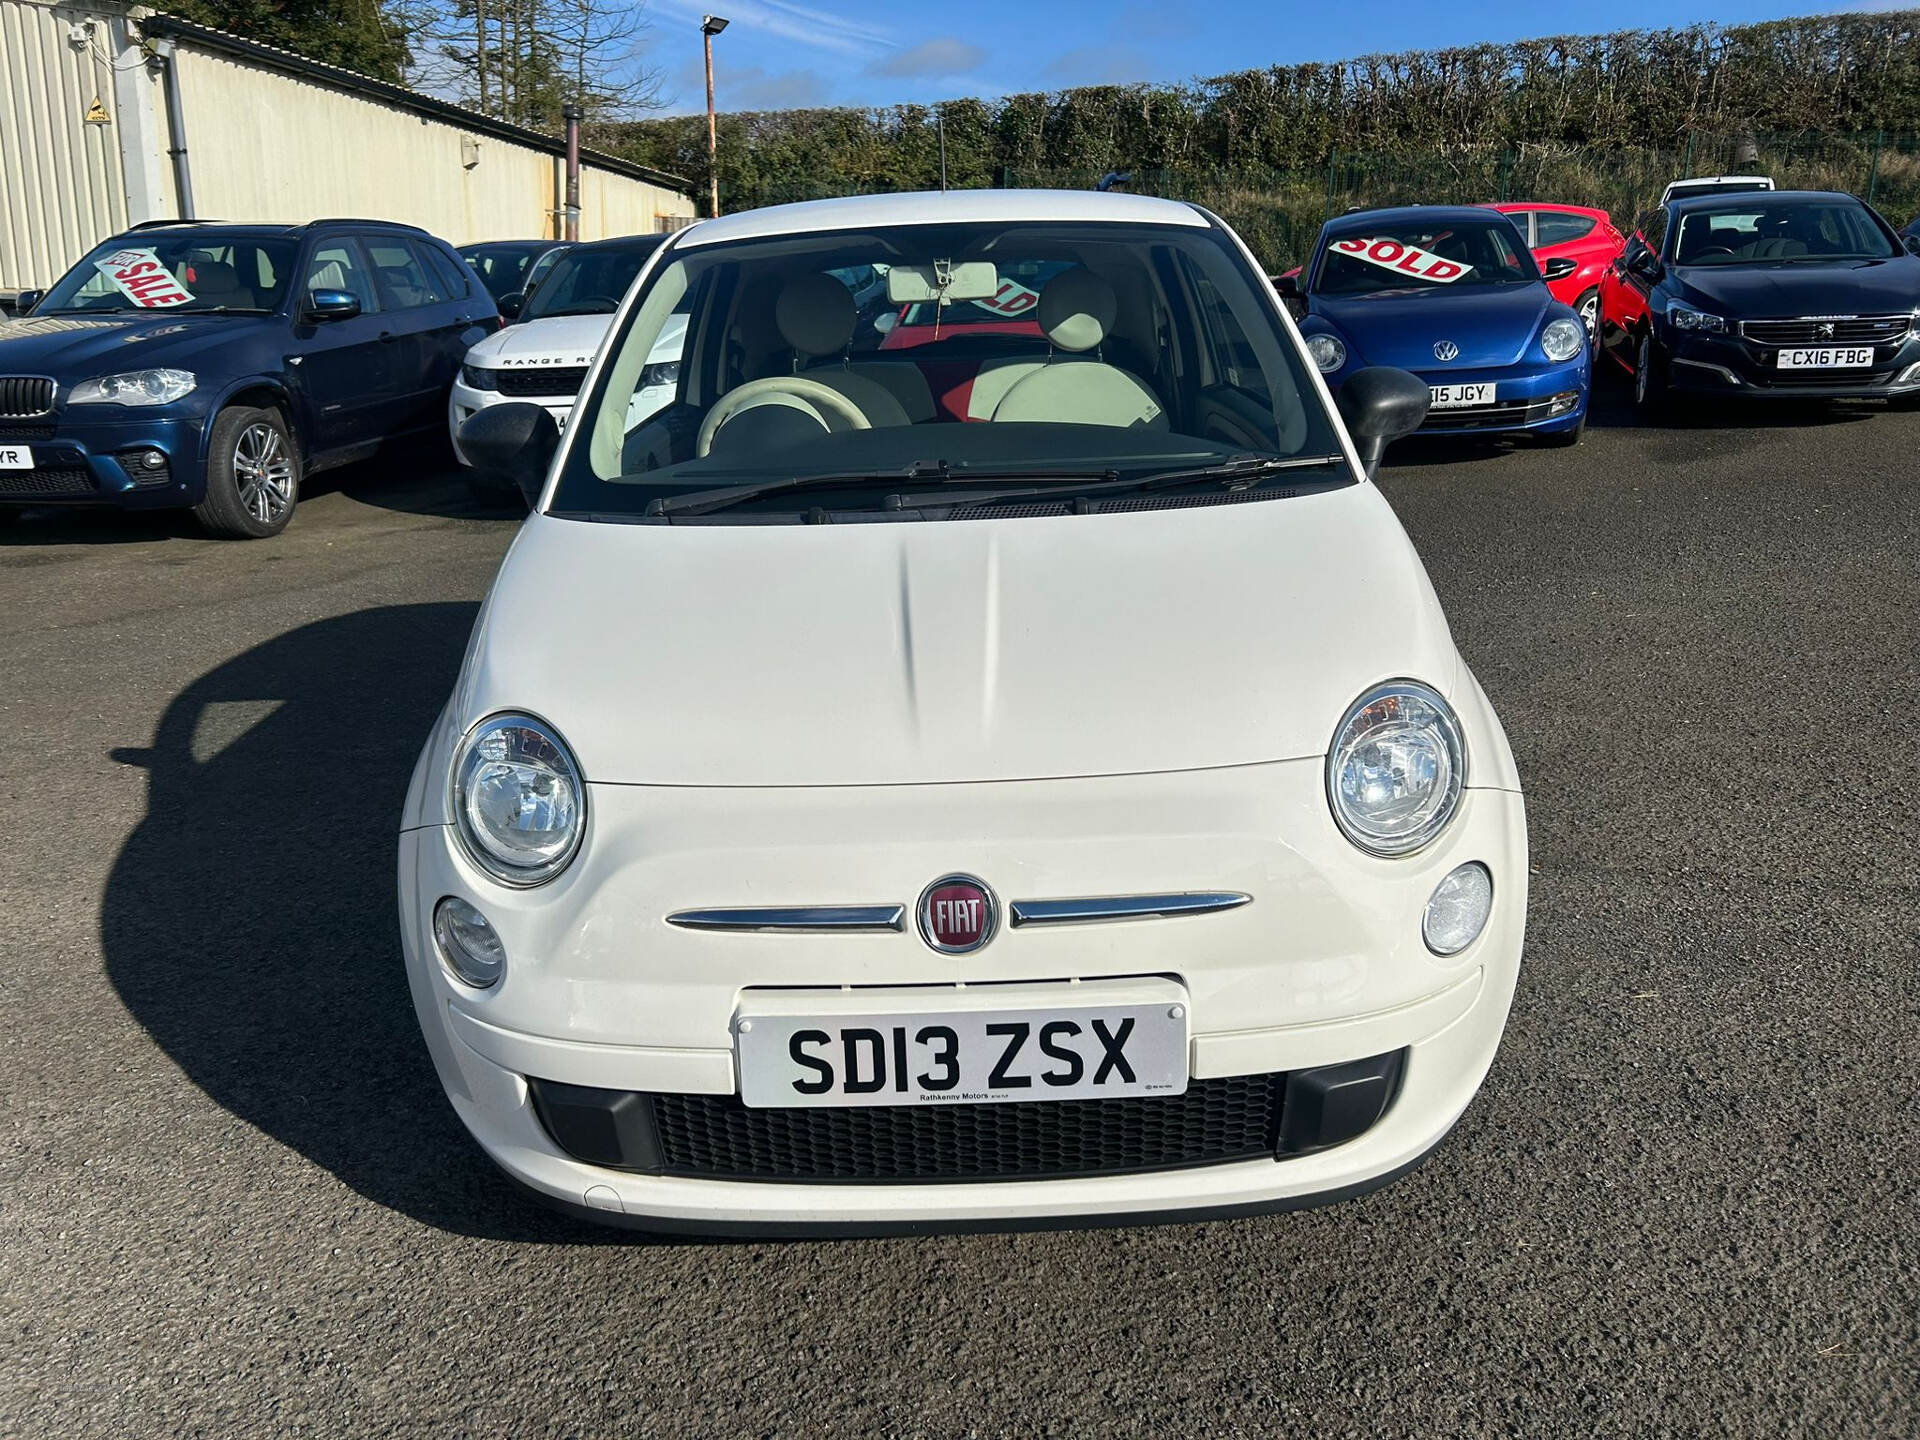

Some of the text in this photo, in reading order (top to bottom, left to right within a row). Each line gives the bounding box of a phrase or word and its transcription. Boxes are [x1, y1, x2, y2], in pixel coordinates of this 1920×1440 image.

[1339, 236, 1462, 279] SOLD
[114, 261, 188, 307] SALE
[502, 358, 563, 366] RANGE
[1792, 349, 1868, 365] CX16 FBG
[1454, 384, 1486, 401] JGY
[936, 898, 980, 934] FIAT
[788, 1017, 1137, 1095] SD13 ZSX
[962, 1092, 989, 1100] Motors
